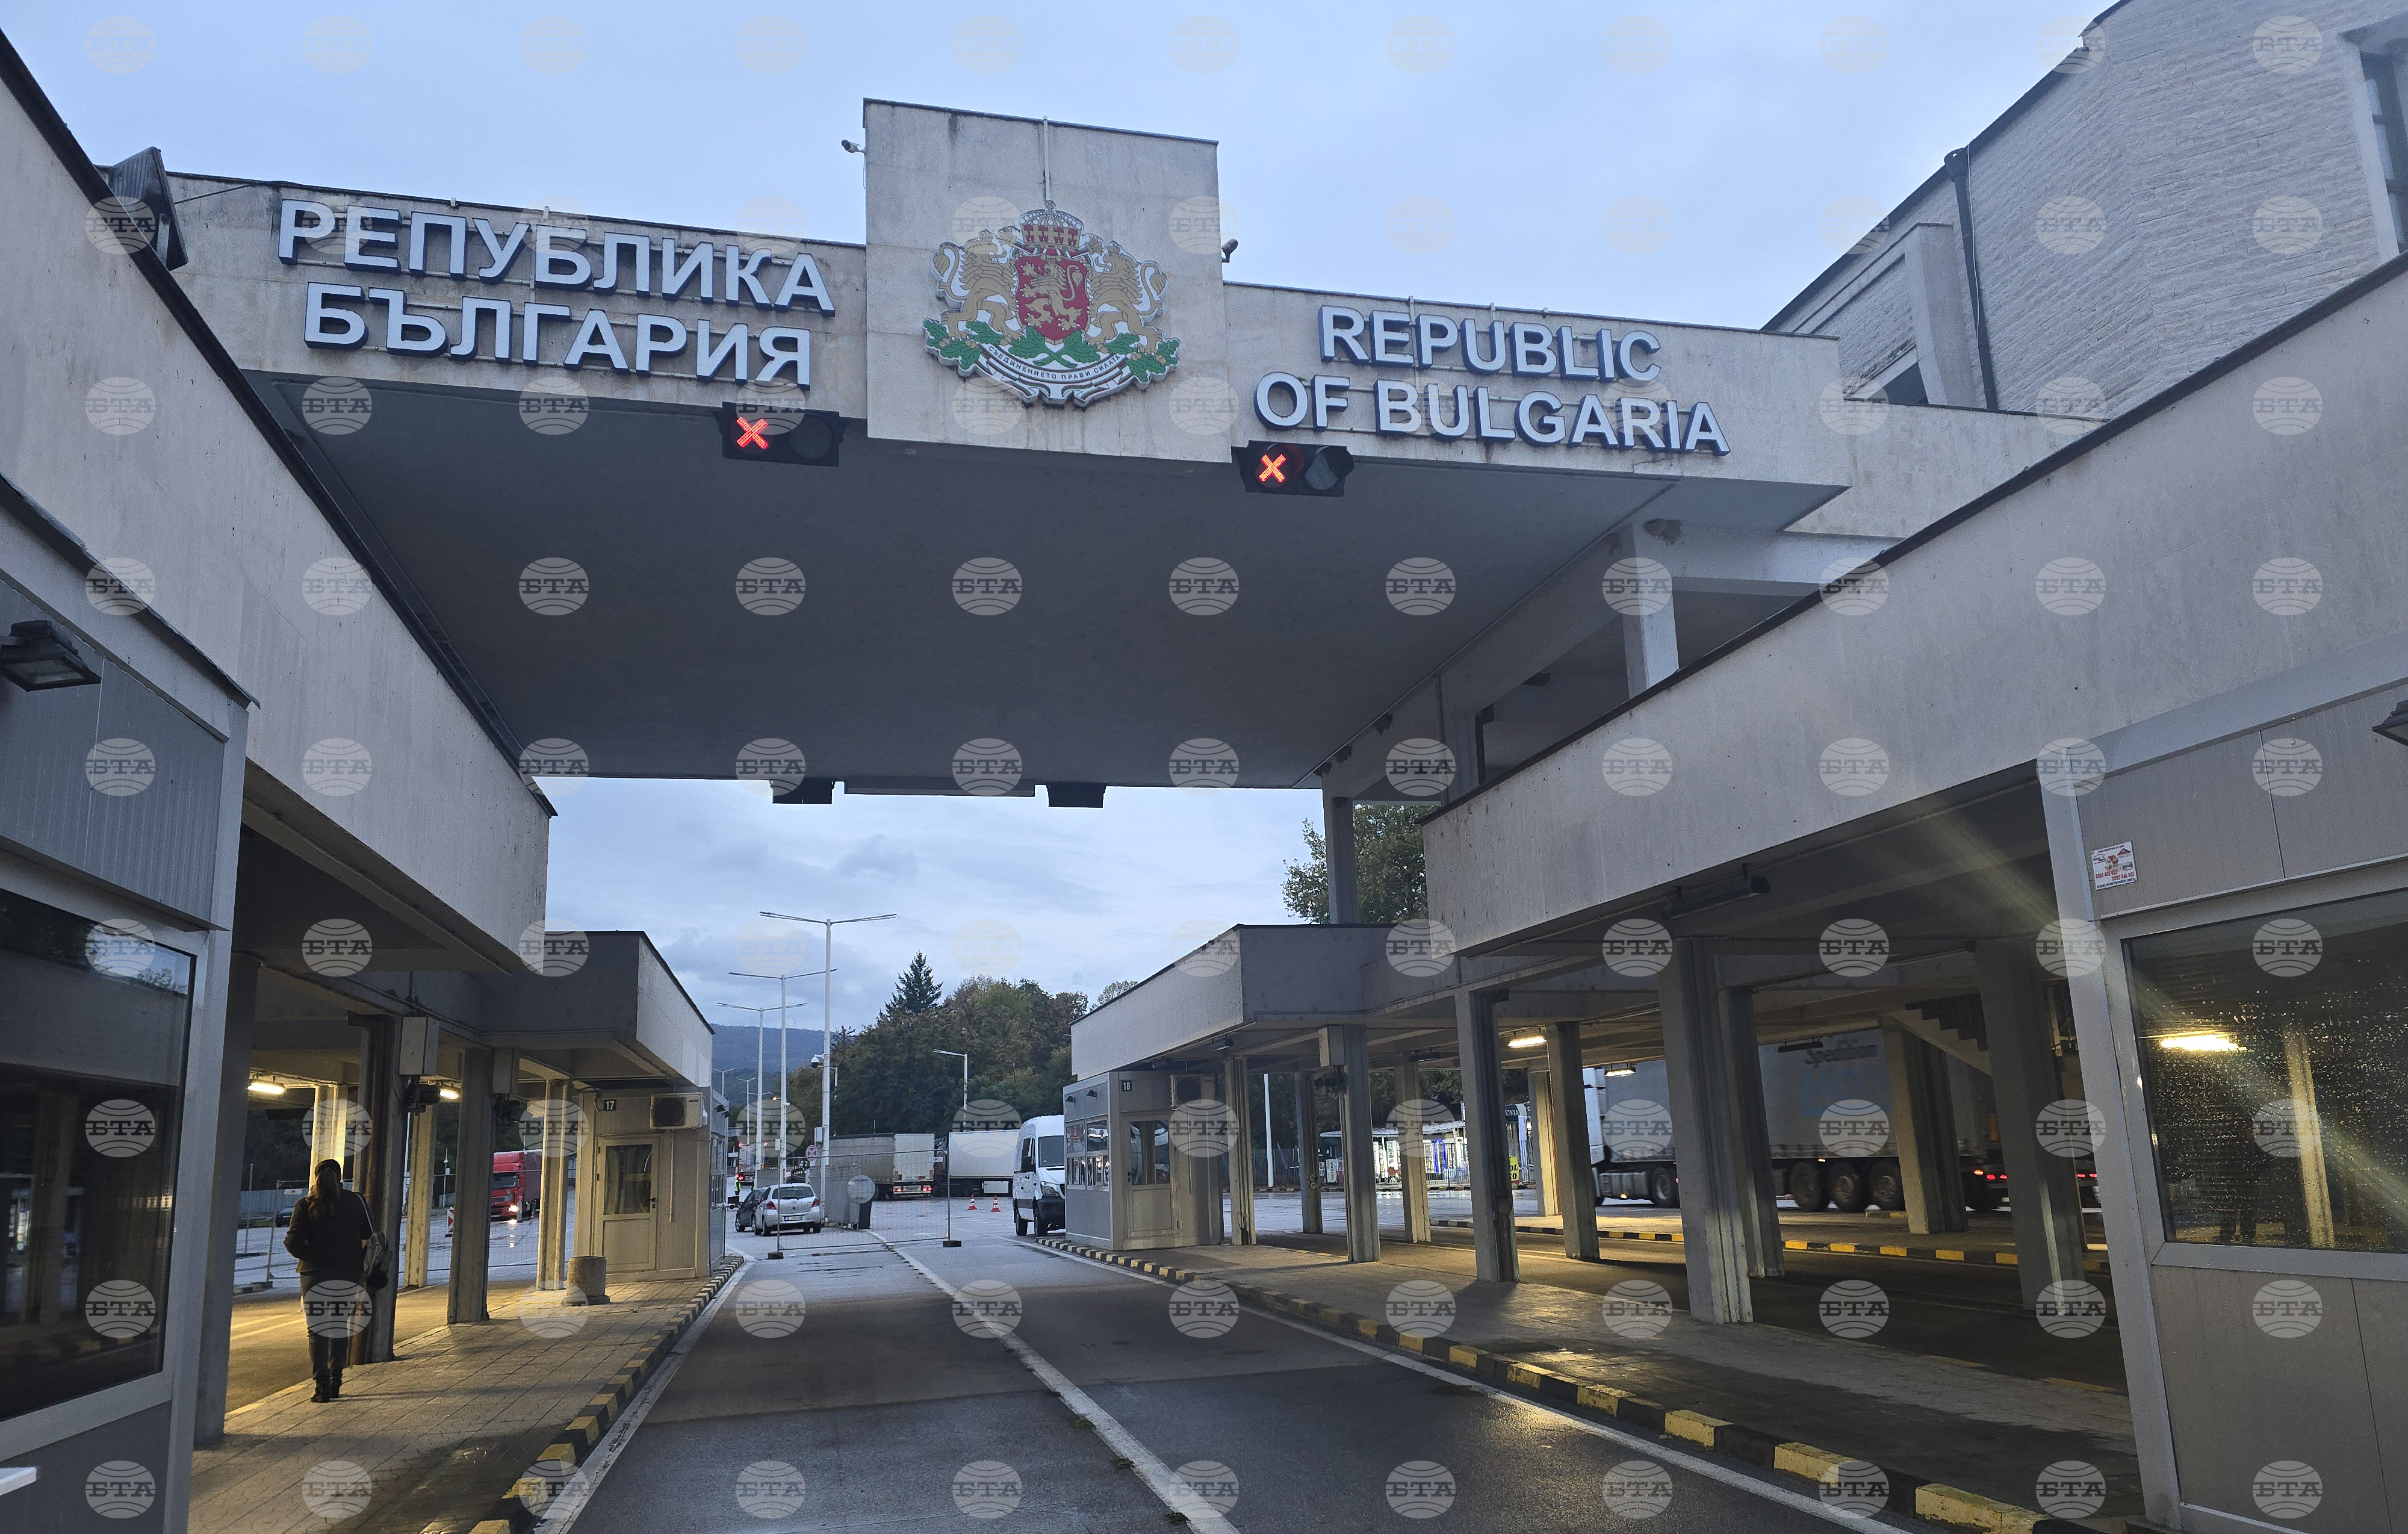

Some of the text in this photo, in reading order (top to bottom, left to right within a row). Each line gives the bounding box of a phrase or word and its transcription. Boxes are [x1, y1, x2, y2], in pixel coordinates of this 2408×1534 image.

[278, 199, 835, 317] РЕПУБЛИКА
[304, 282, 810, 391] БЪЛГАРИЯ
[988, 346, 1121, 380] СЪЕДИНЕНИЕТО ПРАВИ СИЛАТА
[1318, 305, 1662, 382] REPUBLIC
[1254, 371, 1731, 456] OF BULGARIA
[606, 1101, 615, 1110] 17
[1123, 1082, 1131, 1090] 18
